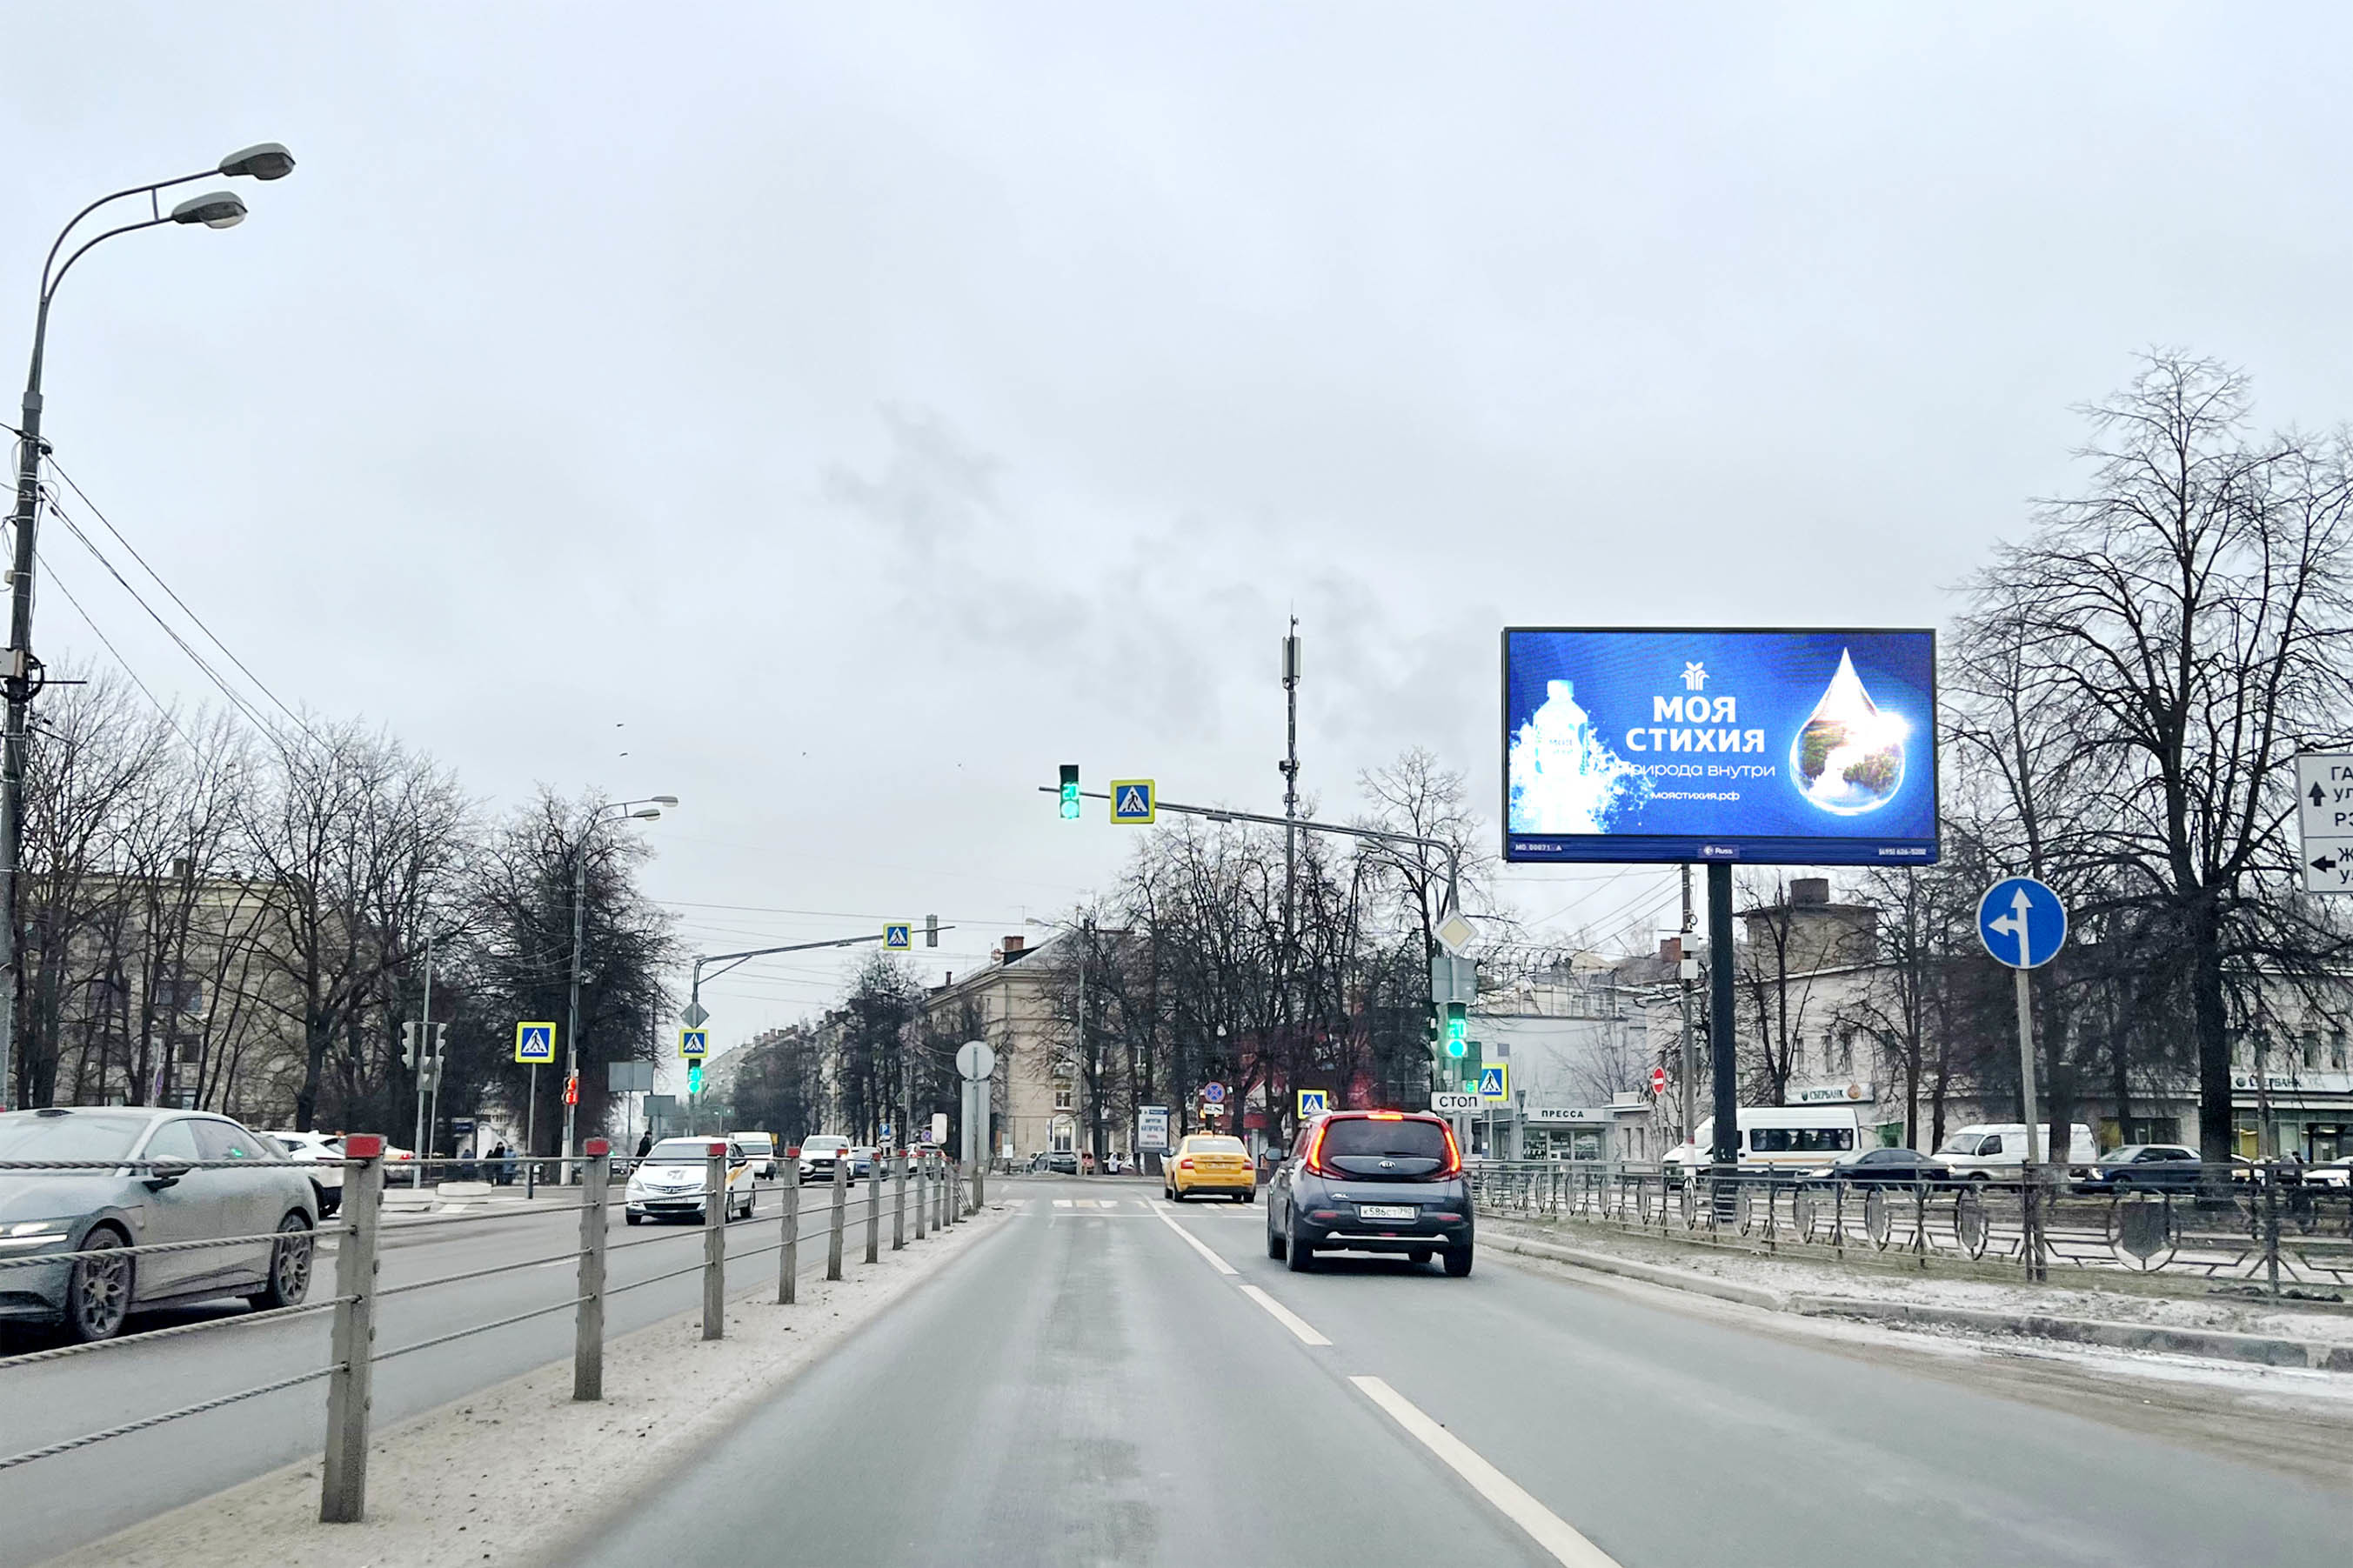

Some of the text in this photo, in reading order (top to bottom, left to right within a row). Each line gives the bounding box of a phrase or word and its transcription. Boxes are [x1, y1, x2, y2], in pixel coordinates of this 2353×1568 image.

[1654, 696, 1736, 724] МОЯ
[1626, 728, 1765, 753] СТИХИЯ
[1622, 764, 1775, 779] рирода внутри
[1651, 791, 1741, 801] моястихия.рф
[1439, 1097, 1478, 1107] СТОП
[1541, 1110, 1584, 1118] ПРЕССА
